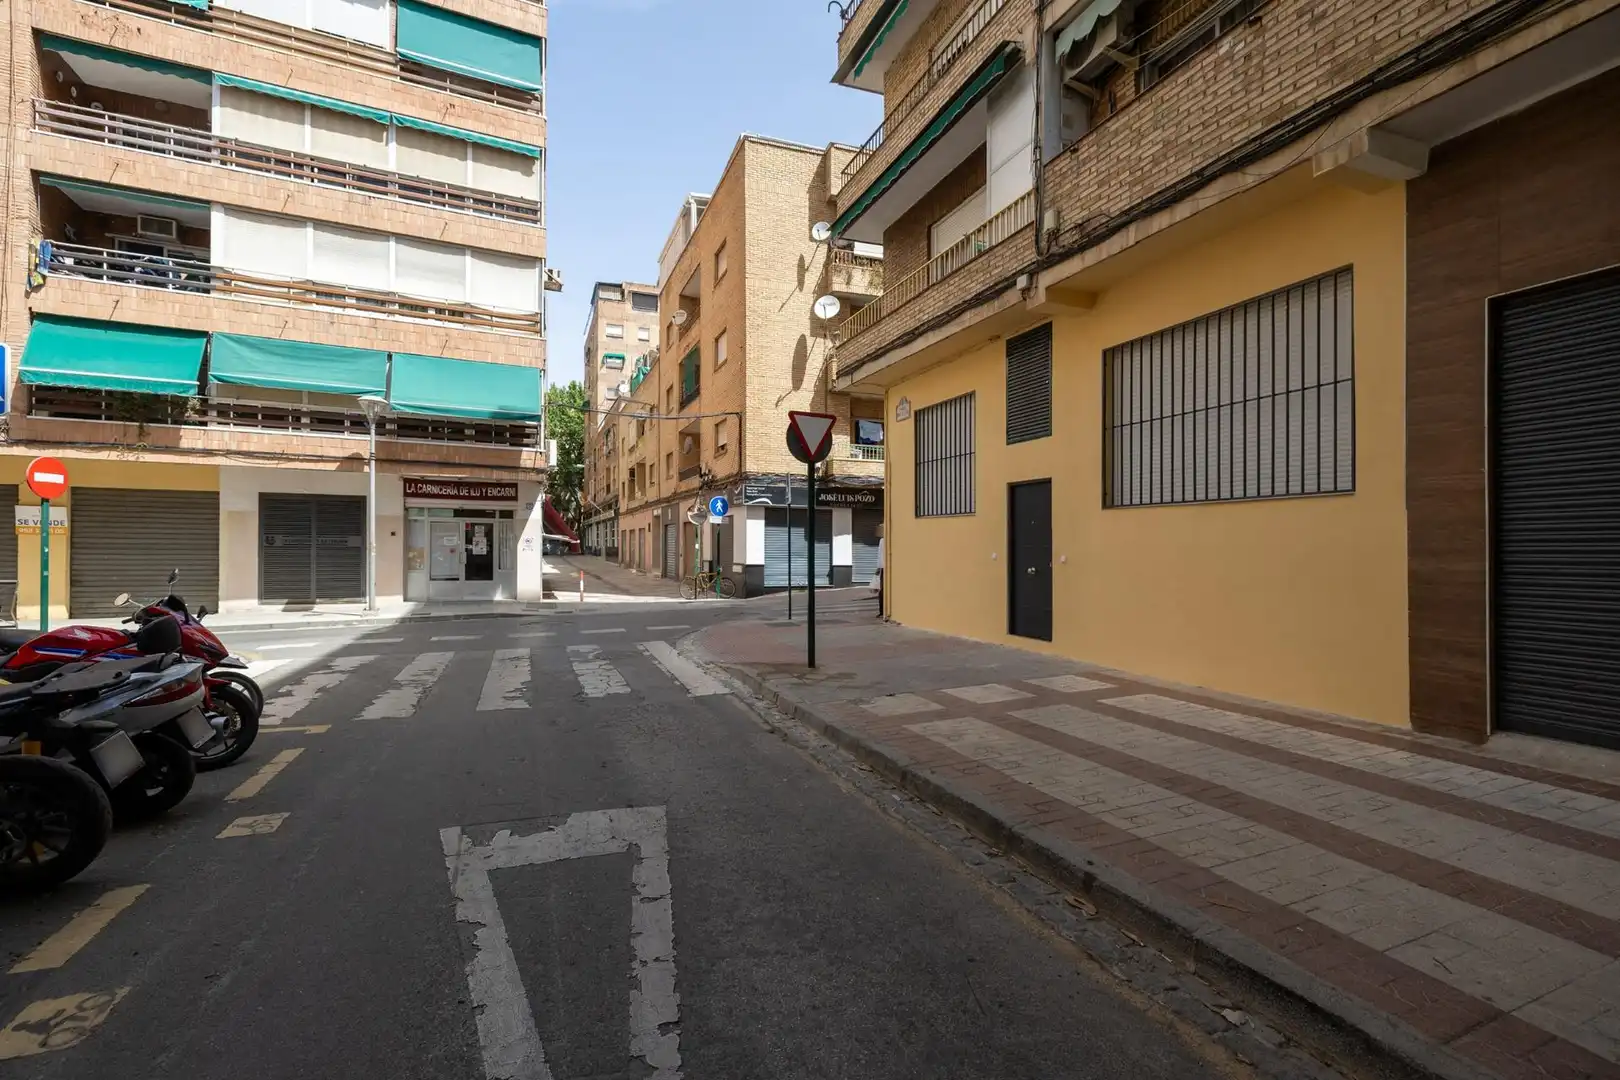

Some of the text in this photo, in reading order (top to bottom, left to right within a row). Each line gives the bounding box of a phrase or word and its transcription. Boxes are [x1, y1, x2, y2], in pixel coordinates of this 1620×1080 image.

[406, 483, 416, 493] LA
[417, 484, 459, 496] CARNICERÍA
[459, 486, 469, 496] DE
[482, 487, 486, 497] Y
[487, 487, 516, 497] ENCARNI
[838, 494, 855, 502] LUIS
[855, 494, 876, 503] POZO
[17, 518, 65, 527] SE VNDE
